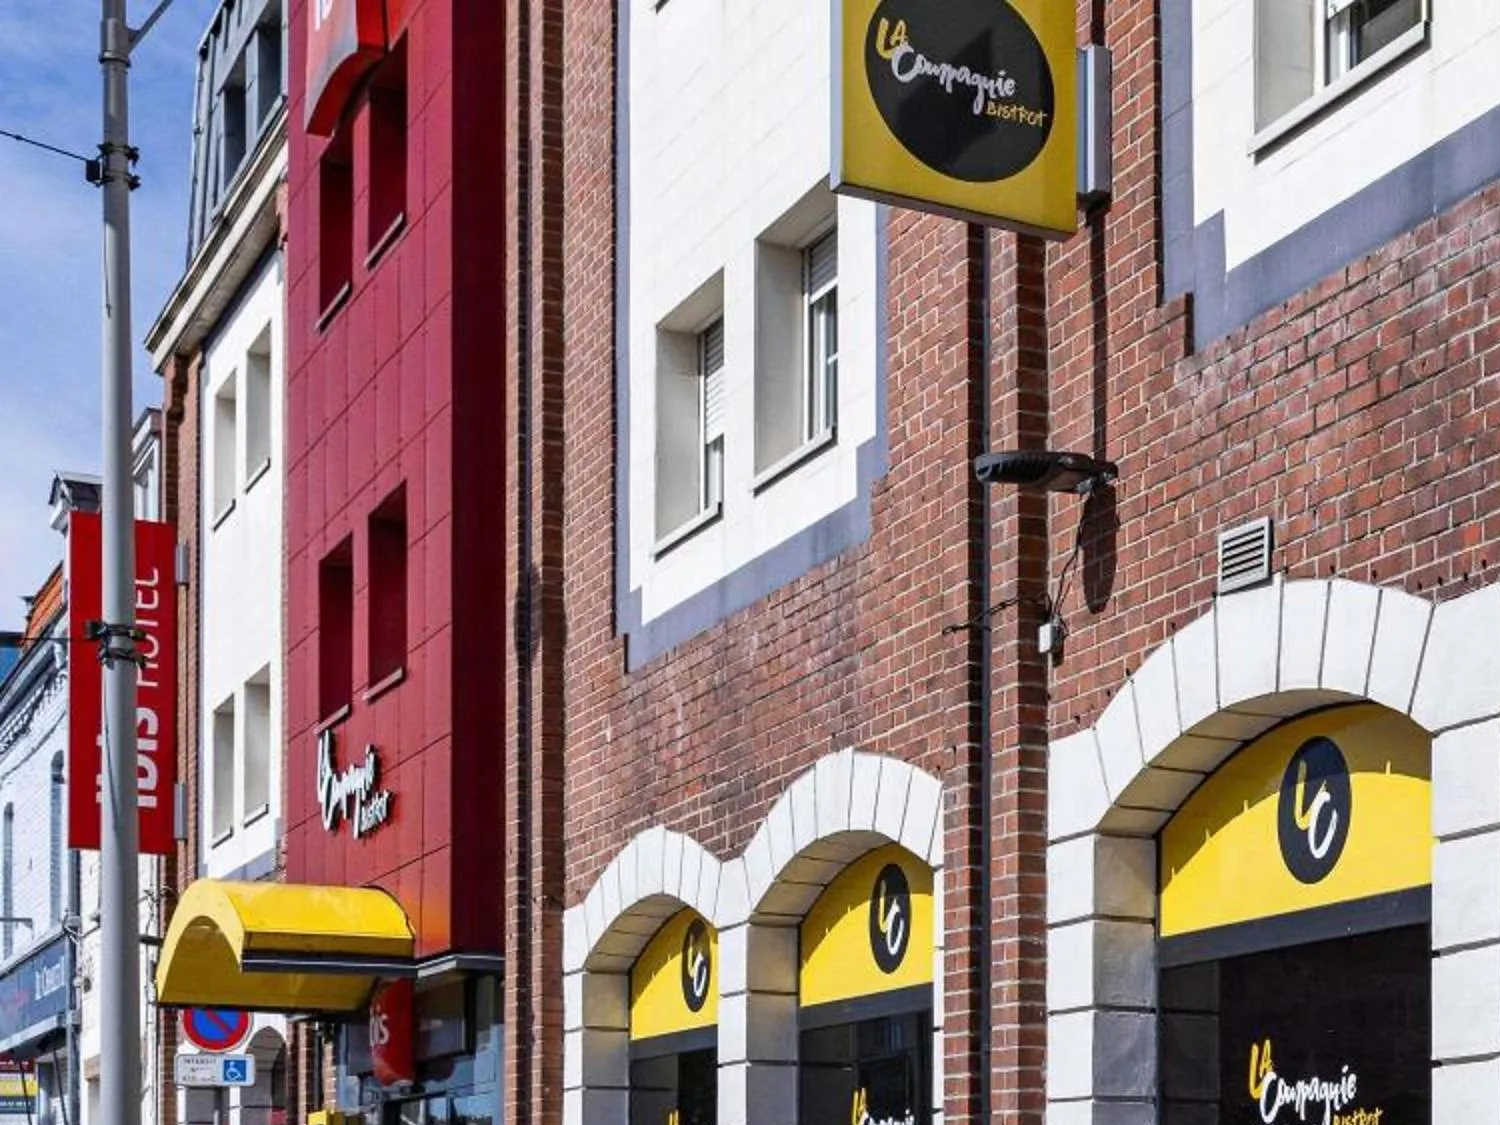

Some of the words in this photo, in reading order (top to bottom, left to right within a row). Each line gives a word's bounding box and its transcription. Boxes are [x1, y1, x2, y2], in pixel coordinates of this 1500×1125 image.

[876, 17, 908, 59] LA
[891, 41, 1017, 115] Compagnie
[1249, 1039, 1273, 1099] LA
